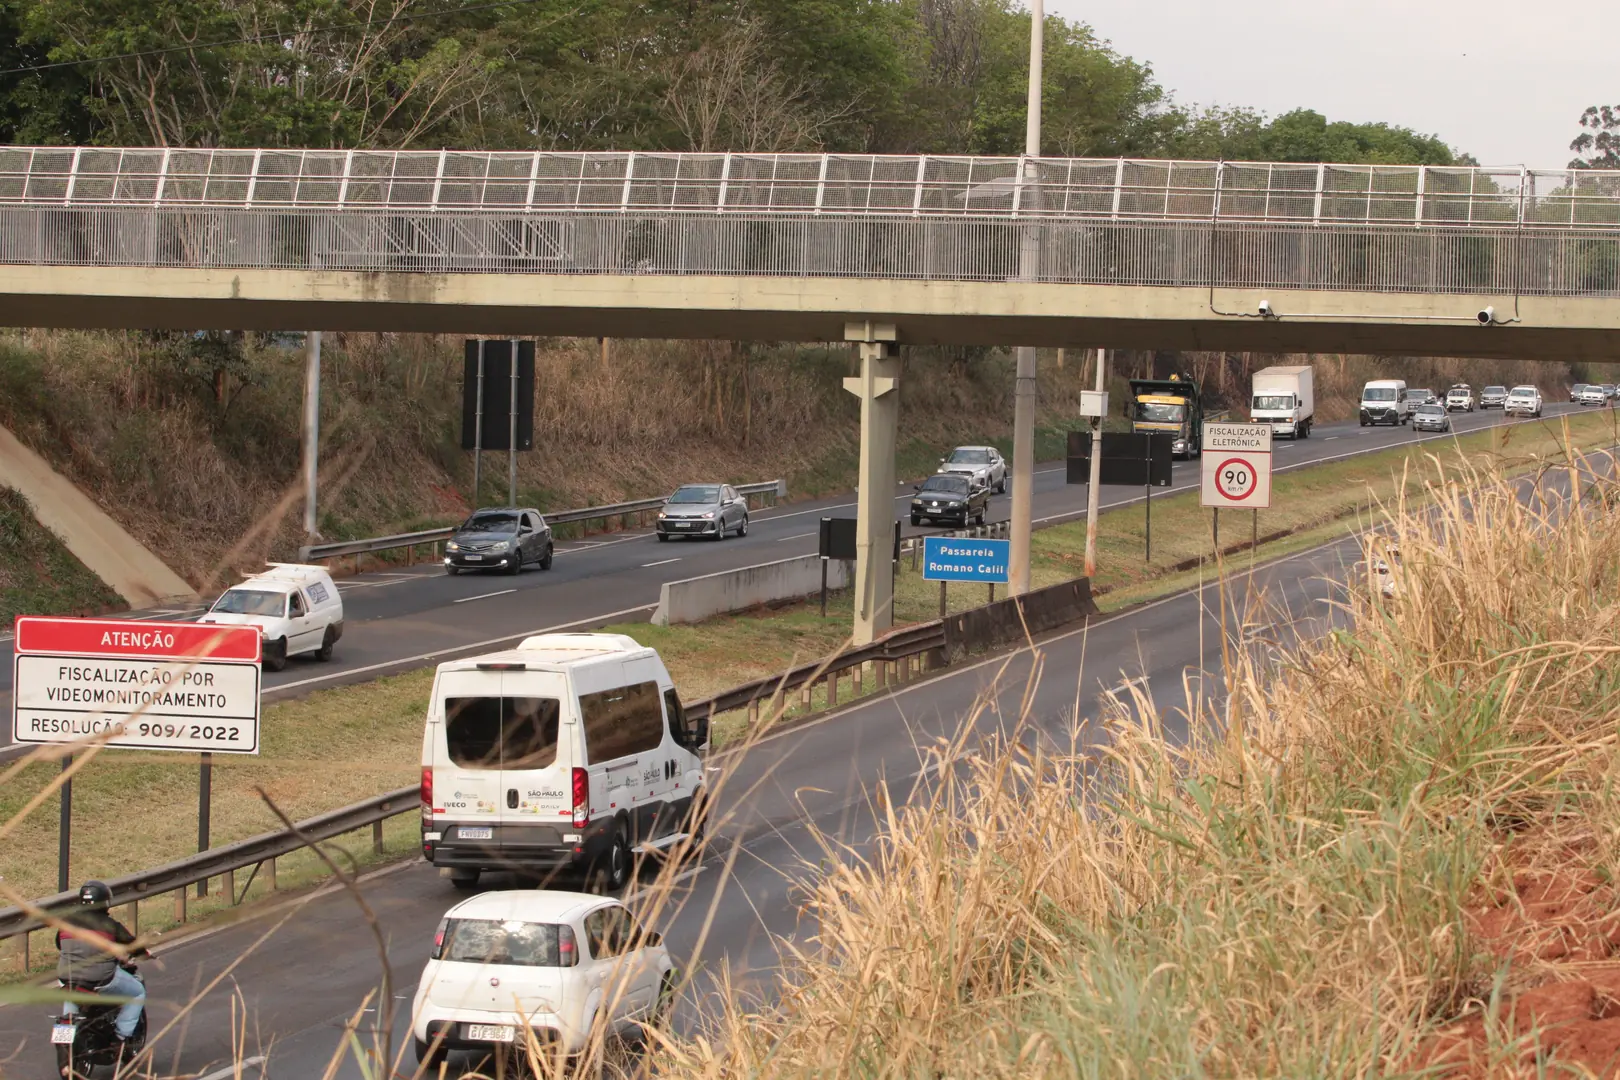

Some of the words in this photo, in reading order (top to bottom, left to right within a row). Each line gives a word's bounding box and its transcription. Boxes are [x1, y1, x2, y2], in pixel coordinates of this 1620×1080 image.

[1209, 427, 1266, 437] FISCALIZAÇÃO
[1212, 436, 1261, 447] ELETRÔNICA
[1225, 470, 1247, 485] 90
[940, 546, 994, 557] Passarela
[929, 562, 974, 573] Romano
[978, 564, 1004, 574] Calil
[100, 630, 175, 649] ATENÇÃO
[59, 667, 172, 686] FISCALIZAÇÃO
[182, 671, 215, 686] POR
[47, 687, 227, 708] VIDEOMONITORAMENTO
